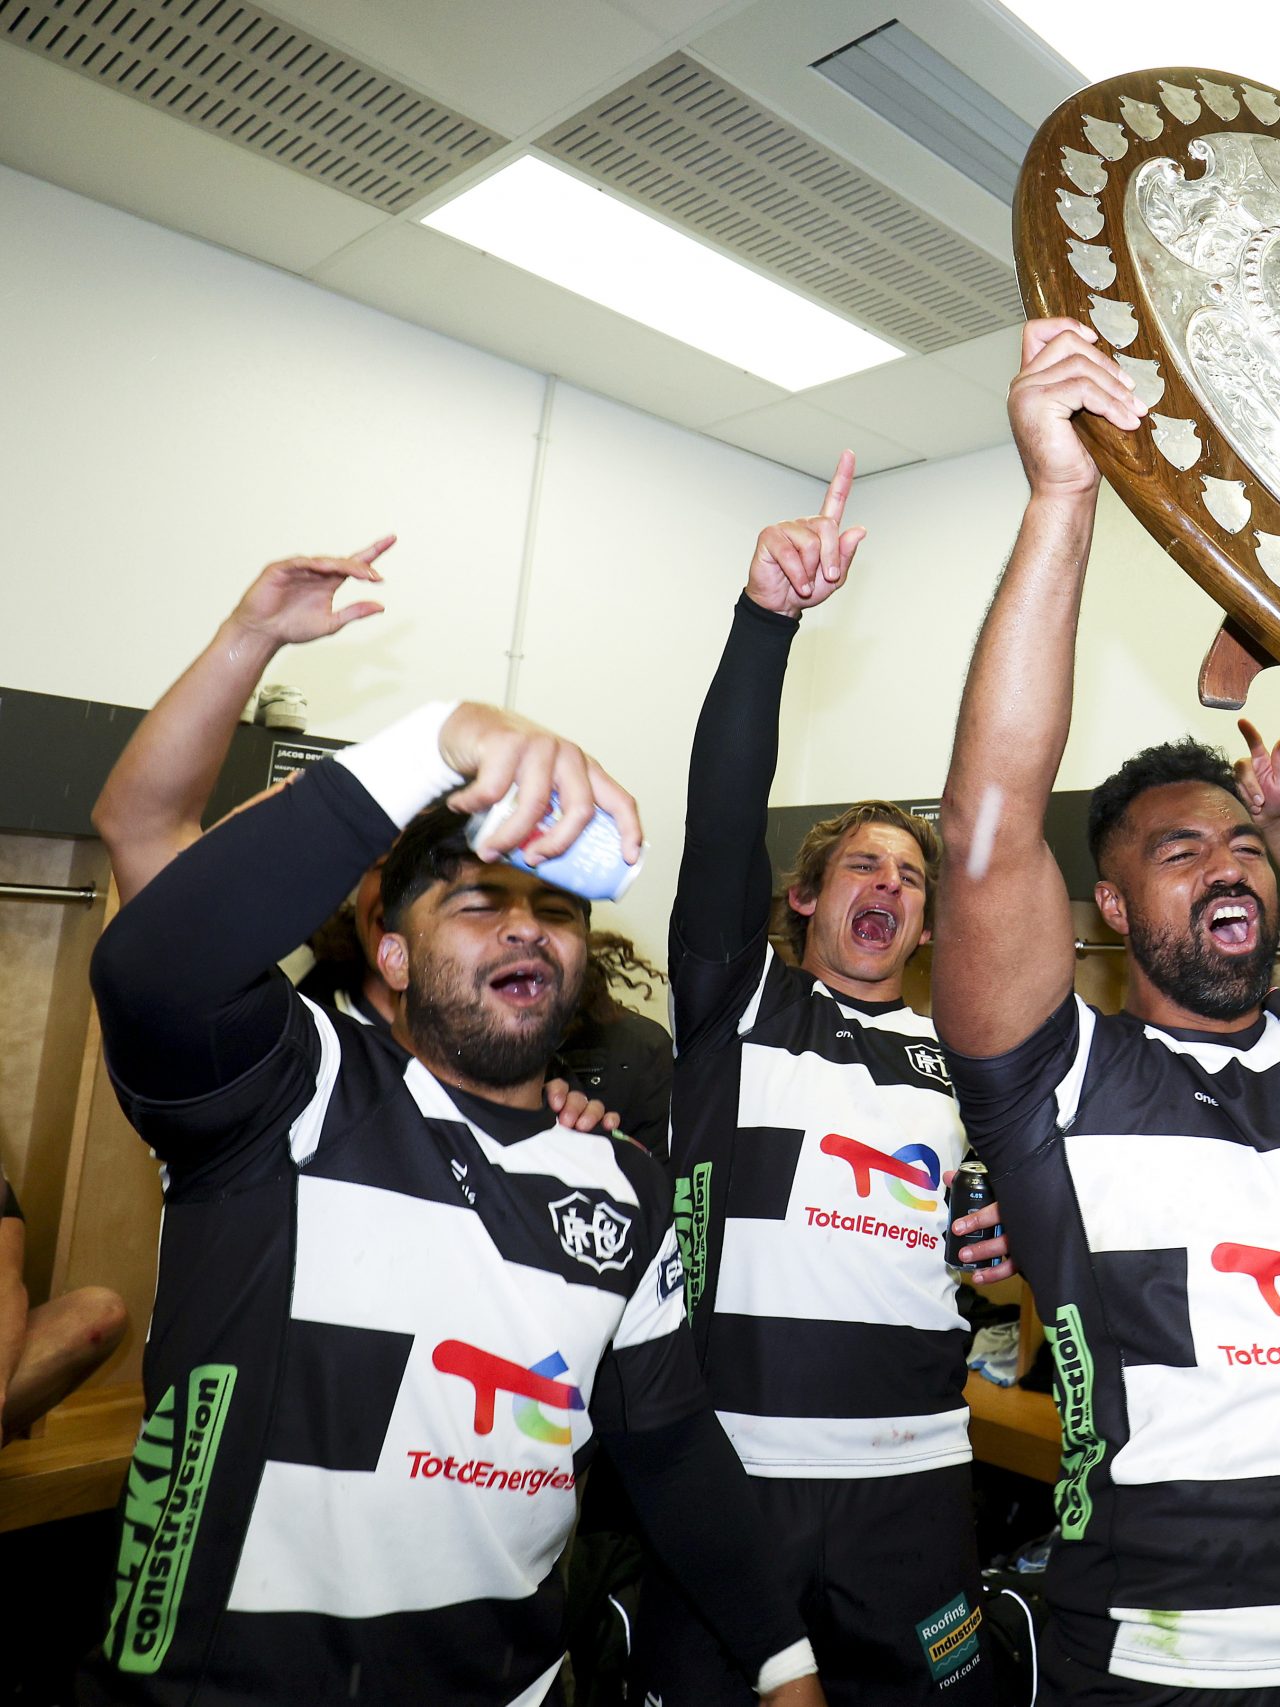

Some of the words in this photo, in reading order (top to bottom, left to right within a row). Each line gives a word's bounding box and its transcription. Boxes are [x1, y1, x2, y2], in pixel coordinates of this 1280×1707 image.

[277, 749, 304, 760] JACOB
[305, 752, 323, 761] DEV
[804, 1206, 939, 1250] TotalEnergies
[133, 1377, 220, 1655] construction
[922, 1603, 966, 1640] Roofing
[932, 1611, 981, 1659] Industries
[939, 1653, 981, 1690] roof.co.nz
